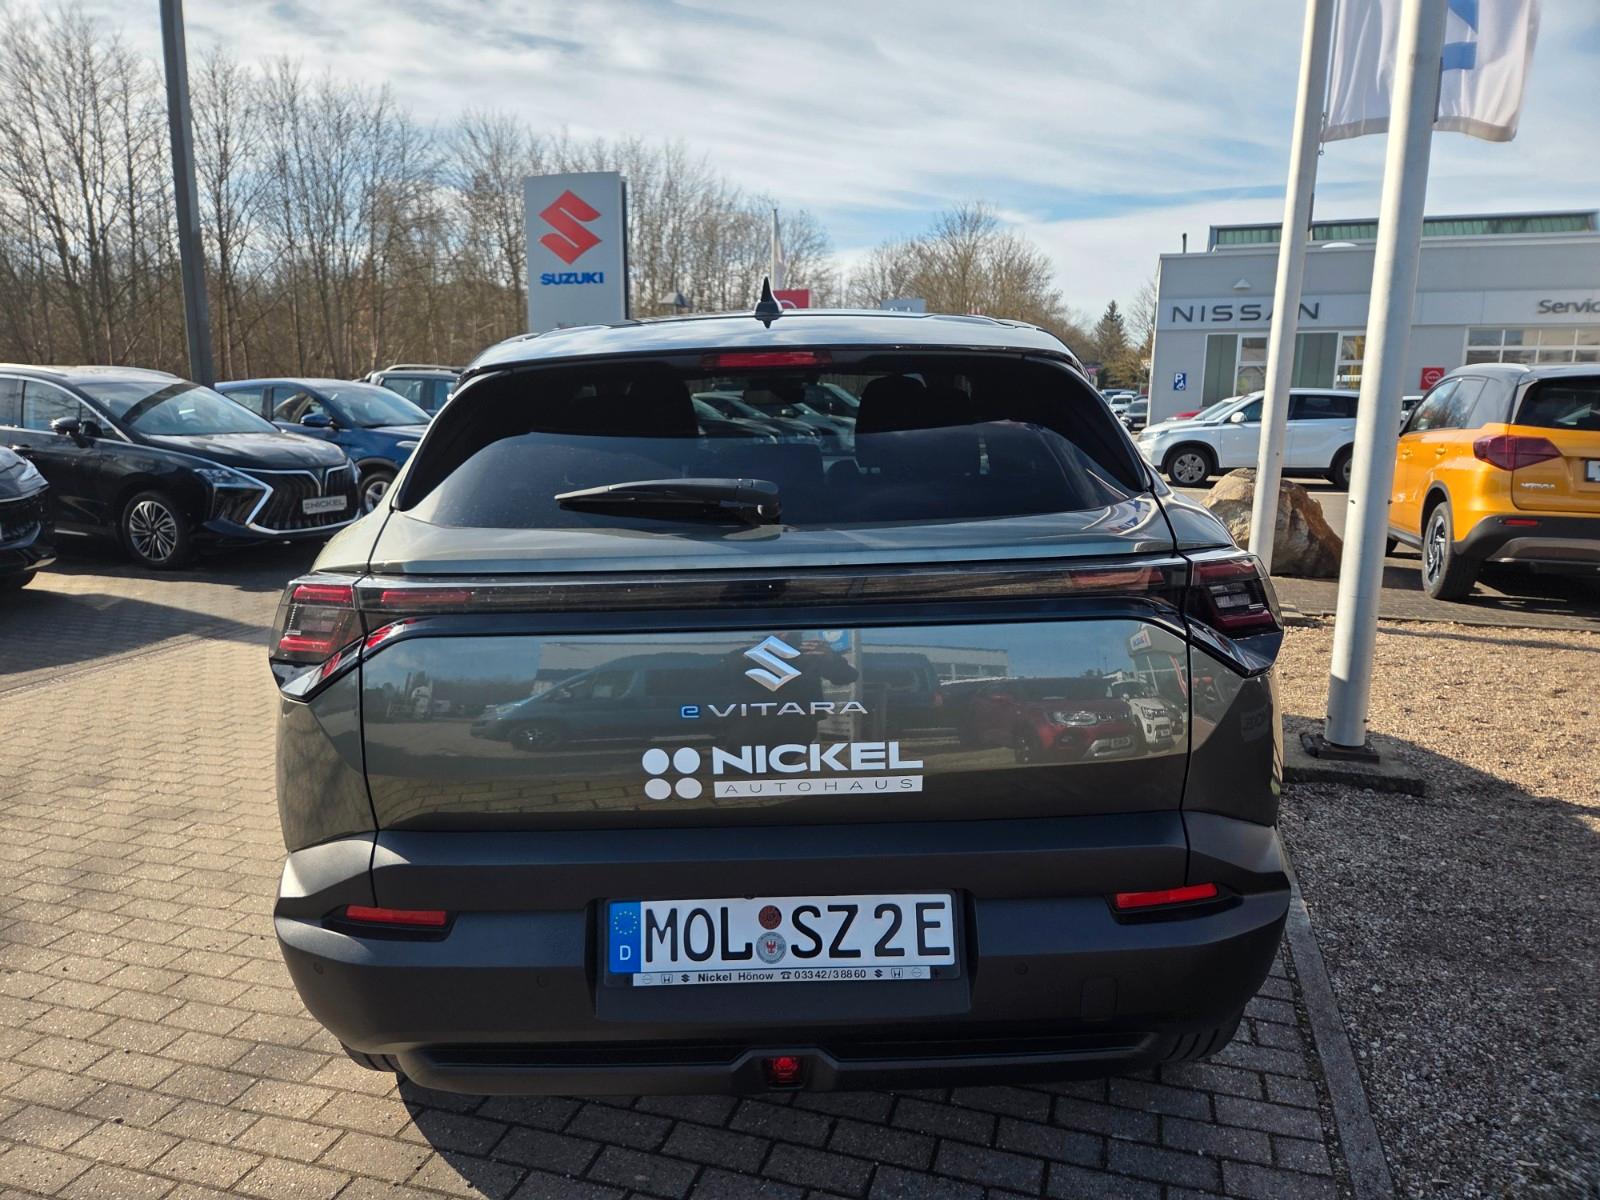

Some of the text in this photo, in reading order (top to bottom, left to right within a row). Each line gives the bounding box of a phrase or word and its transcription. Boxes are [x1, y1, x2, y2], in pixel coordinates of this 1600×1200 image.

[540, 271, 605, 286] SUZUKI
[1172, 302, 1320, 323] NISSN
[1175, 373, 1184, 383] P
[708, 701, 869, 717] VITARA
[712, 741, 924, 774] NICKEL
[724, 778, 913, 793] AUTOHAUS
[645, 907, 753, 962] MOL
[619, 945, 631, 961] D
[698, 972, 732, 983] Nickel
[738, 972, 774, 981] Hönow
